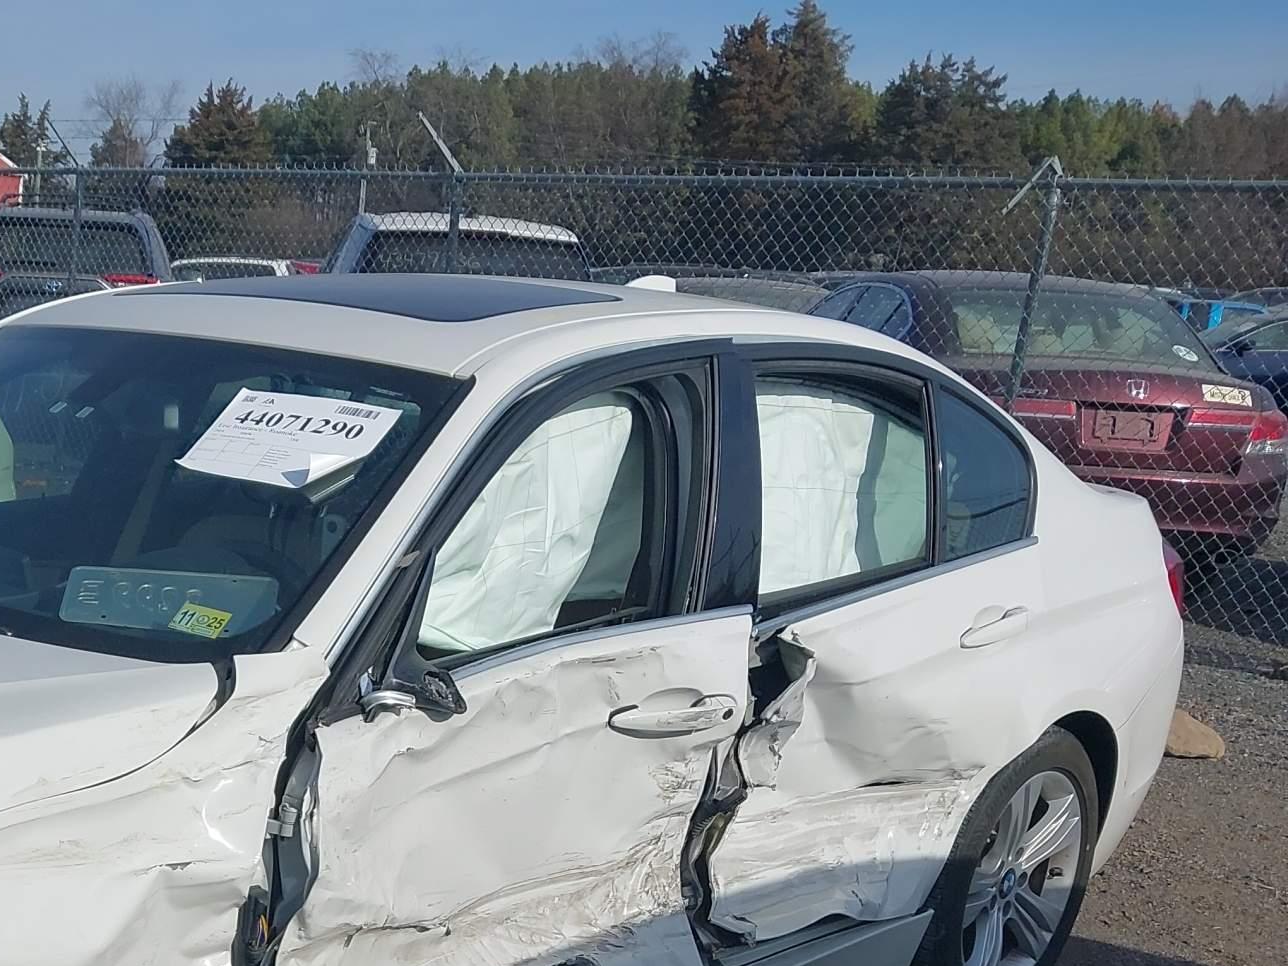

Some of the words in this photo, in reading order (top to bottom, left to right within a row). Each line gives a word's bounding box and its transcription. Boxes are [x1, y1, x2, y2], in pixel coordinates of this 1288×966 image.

[234, 409, 365, 440] 44071290
[178, 609, 197, 626] 11
[206, 616, 225, 629] 25
